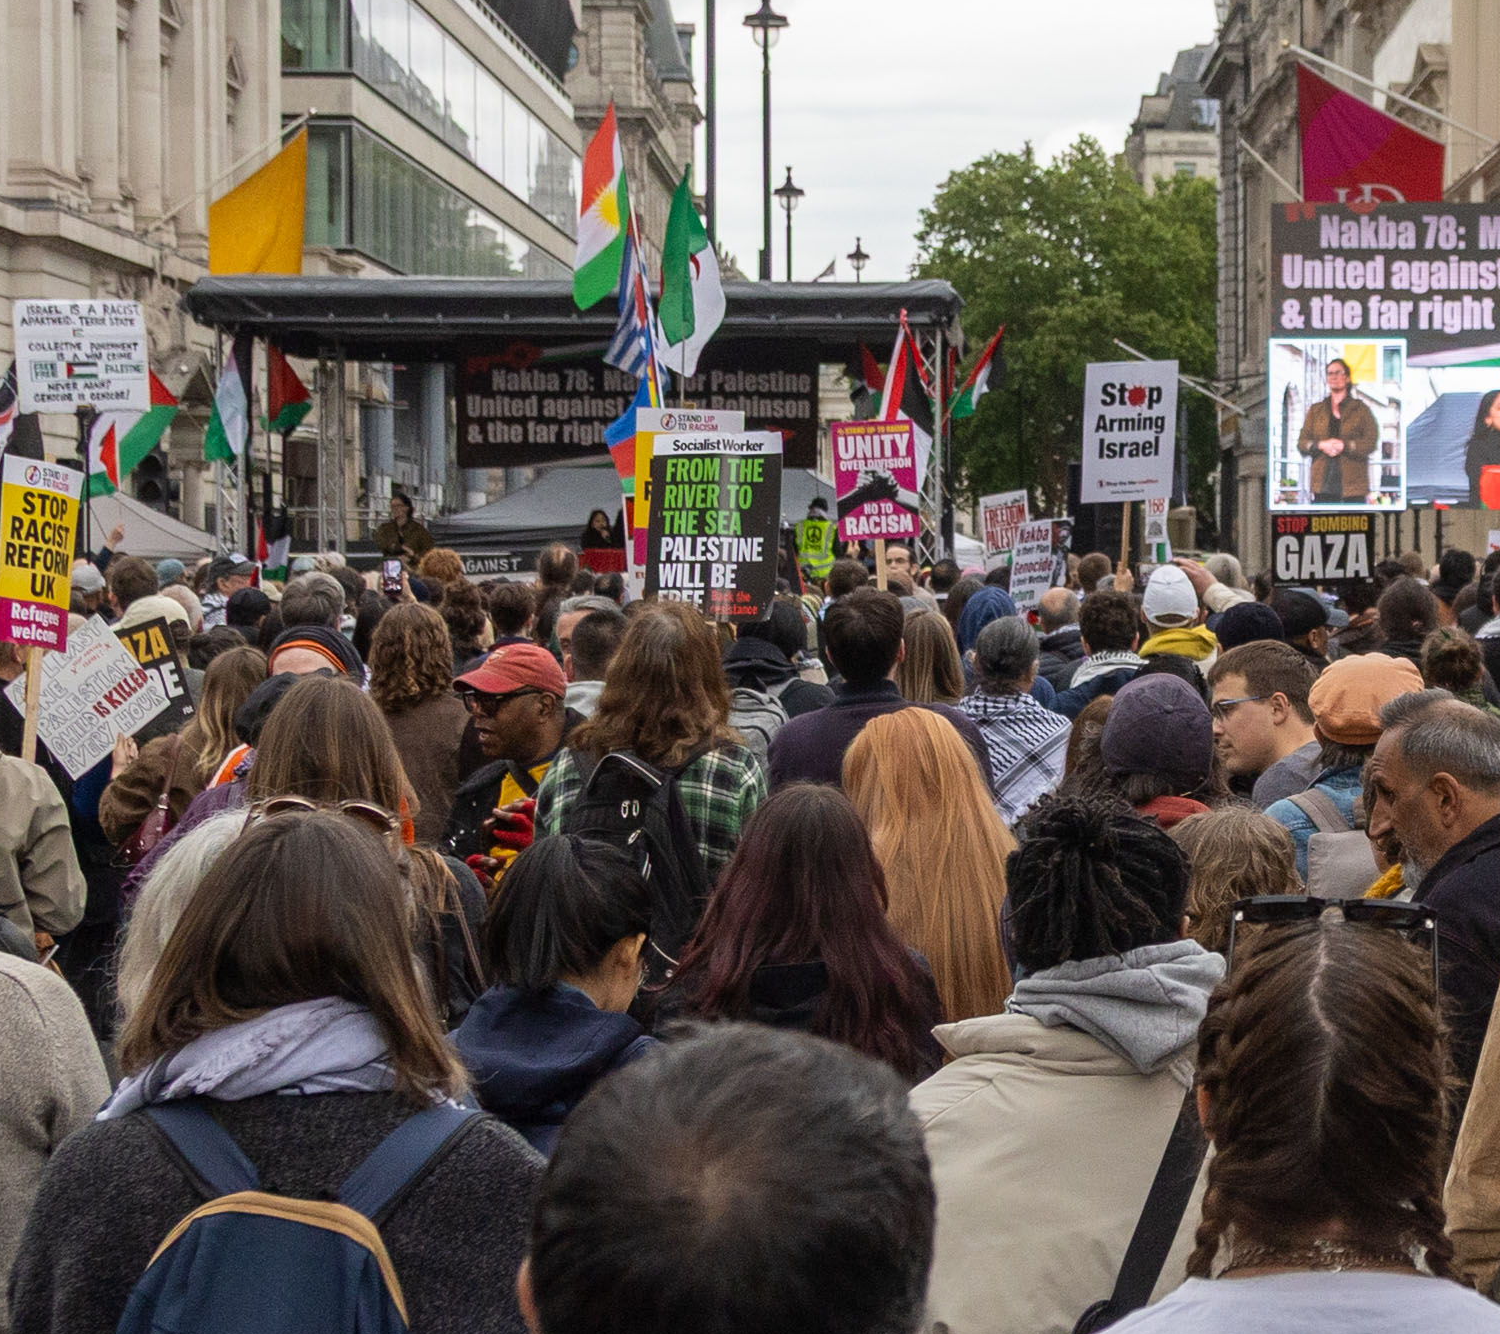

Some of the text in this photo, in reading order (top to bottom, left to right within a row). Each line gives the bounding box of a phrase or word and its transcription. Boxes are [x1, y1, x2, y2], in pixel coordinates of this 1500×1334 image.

[1320, 215, 1416, 250] Nakba
[1422, 215, 1466, 250] 78:
[1282, 254, 1385, 290] United
[70, 305, 79, 315] IS
[88, 305, 97, 315] A
[103, 304, 140, 316] RACIST
[1281, 295, 1495, 334] & the far right
[492, 369, 560, 392] Nakba
[711, 369, 811, 393] Palestine
[467, 396, 538, 418] United
[541, 396, 624, 421] against
[711, 396, 811, 419] Robinson
[1100, 382, 1163, 410] Stop
[678, 415, 715, 423] STAND UP
[688, 424, 718, 432] RACISM
[1094, 412, 1166, 434] Arming
[468, 422, 606, 446] & the far righ
[672, 439, 765, 452] Socialist Worker
[837, 433, 910, 459] UNITY
[1098, 435, 1160, 459] Israel
[666, 458, 720, 482] FROM
[727, 458, 765, 482] THE
[840, 457, 912, 472] OVER DIVISION
[22, 491, 67, 521] STOP
[664, 484, 753, 509] RIVER TO
[863, 503, 893, 515] NO TO
[662, 510, 742, 535] THE SEA
[845, 513, 913, 536] RACISM
[984, 504, 1025, 530] FREEDOM
[1277, 516, 1368, 533] STOP BOMBING
[11, 516, 70, 550] RACIST
[1019, 527, 1049, 544] Nakba
[5, 542, 69, 578] REFORM
[660, 537, 764, 562] PALESTINE
[1276, 534, 1369, 580] GAZA
[658, 563, 738, 589] WILL BE
[1014, 558, 1053, 575] Genocide
[31, 572, 56, 600] UK
[93, 700, 110, 718] IS
[103, 667, 149, 708] KILLED
